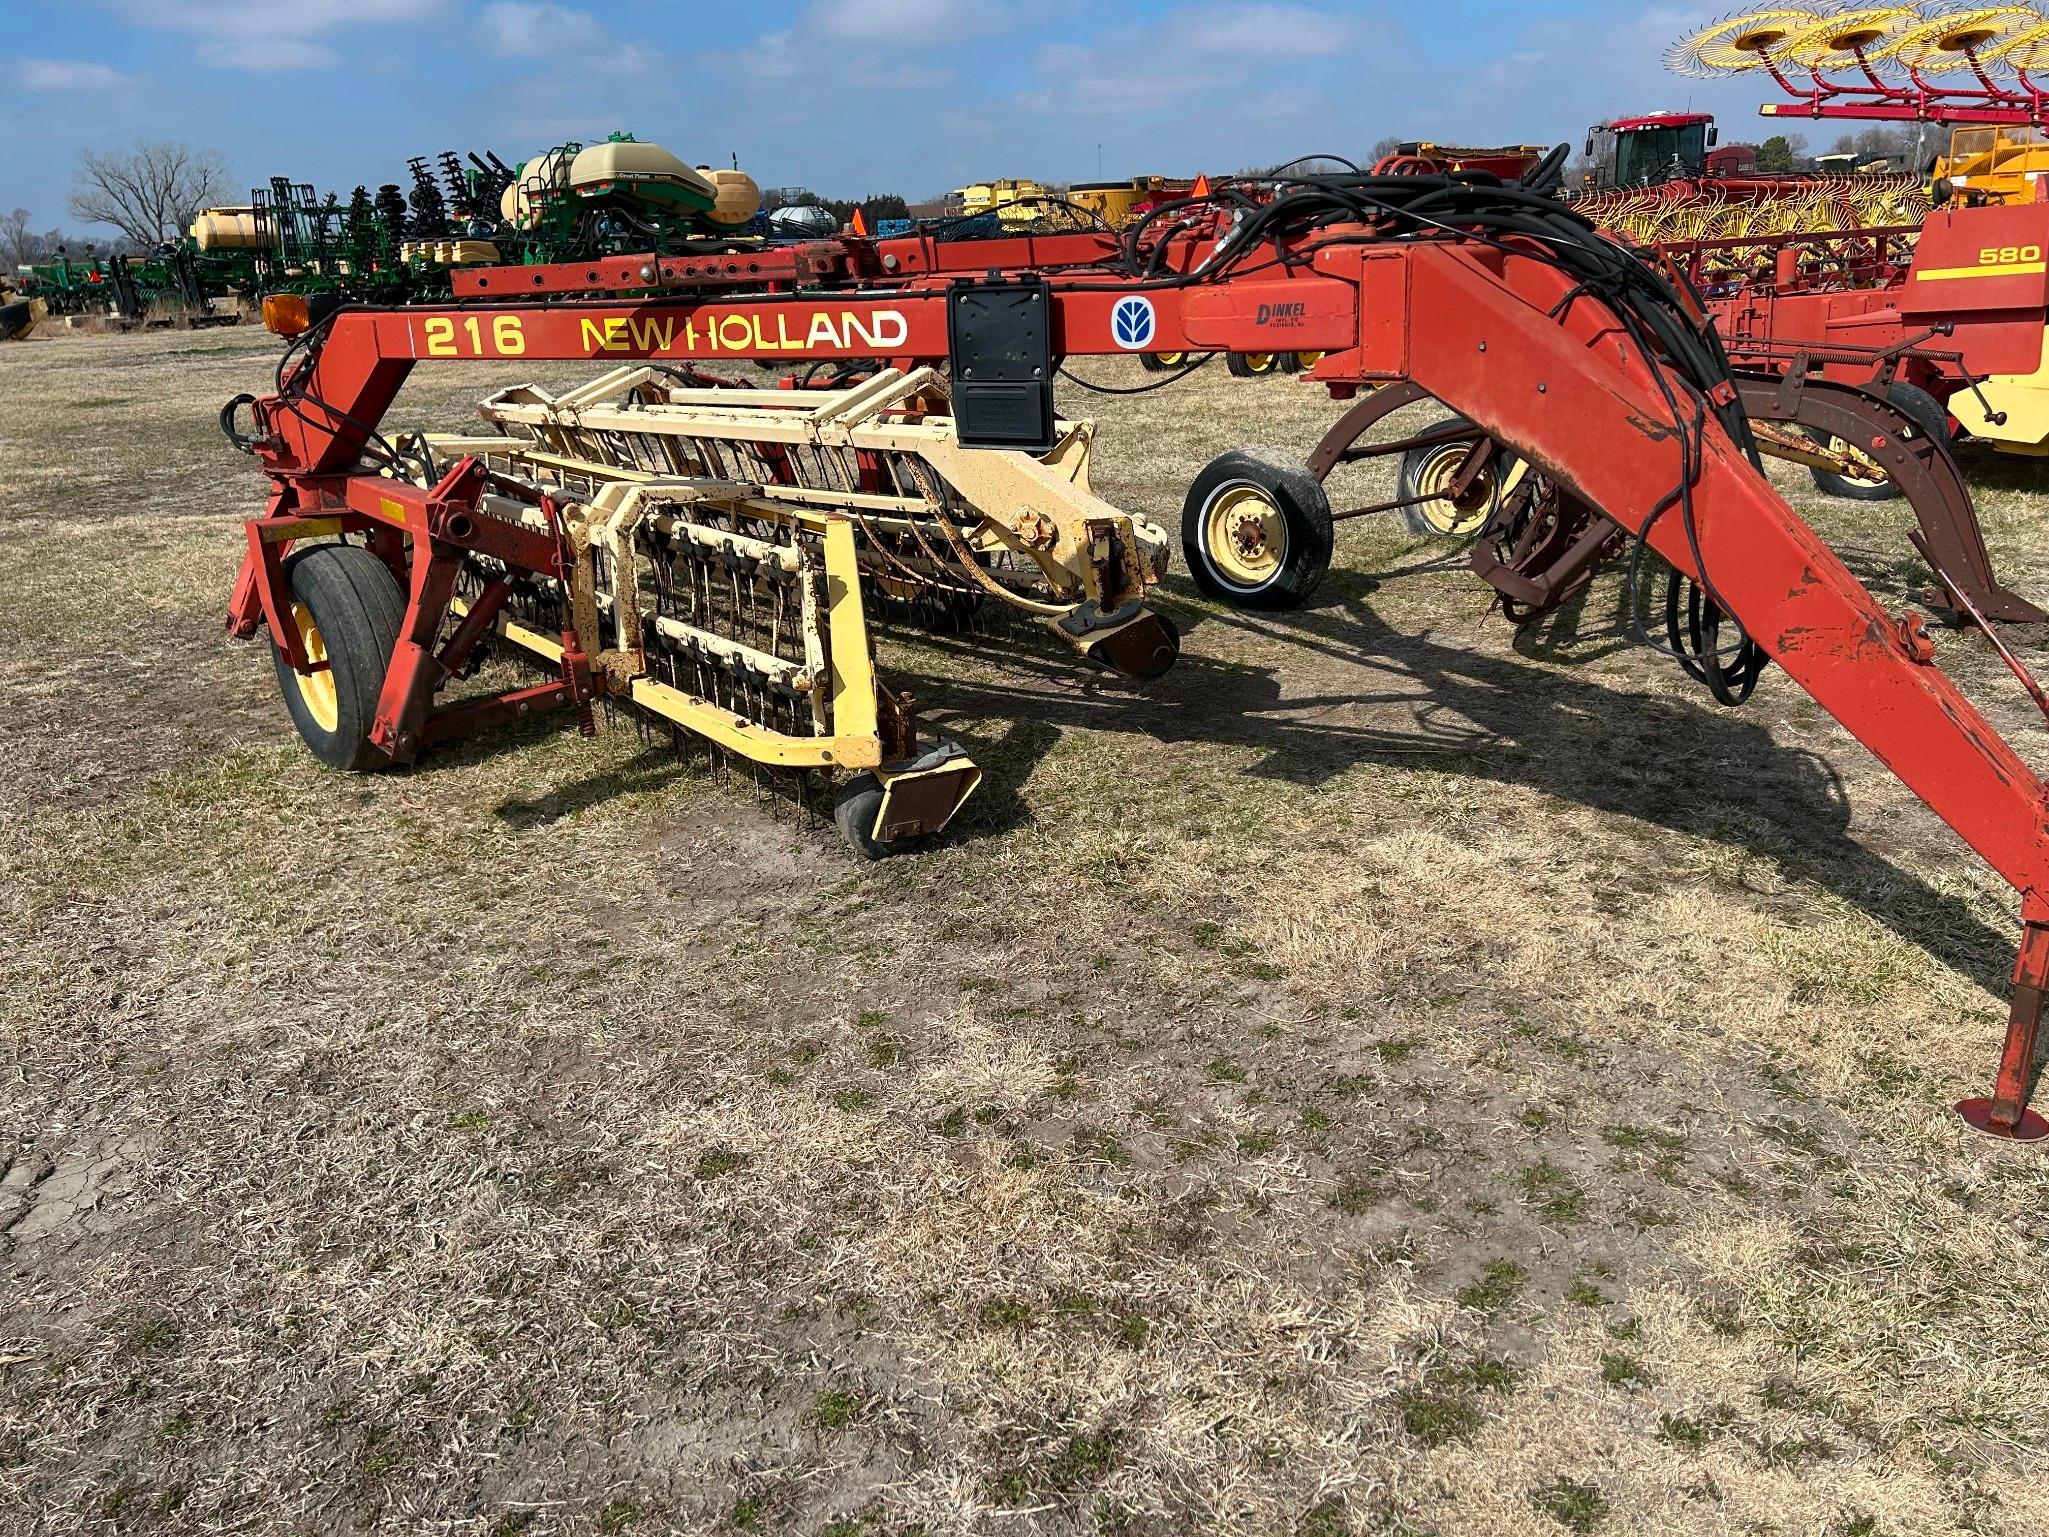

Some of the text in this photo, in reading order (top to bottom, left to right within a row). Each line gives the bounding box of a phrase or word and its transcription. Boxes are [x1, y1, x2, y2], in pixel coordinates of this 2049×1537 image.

[1979, 245, 2041, 265] 580
[1255, 302, 1306, 325] DINKEL
[425, 315, 525, 355] 216
[580, 309, 908, 352] NEW HOLLAND
